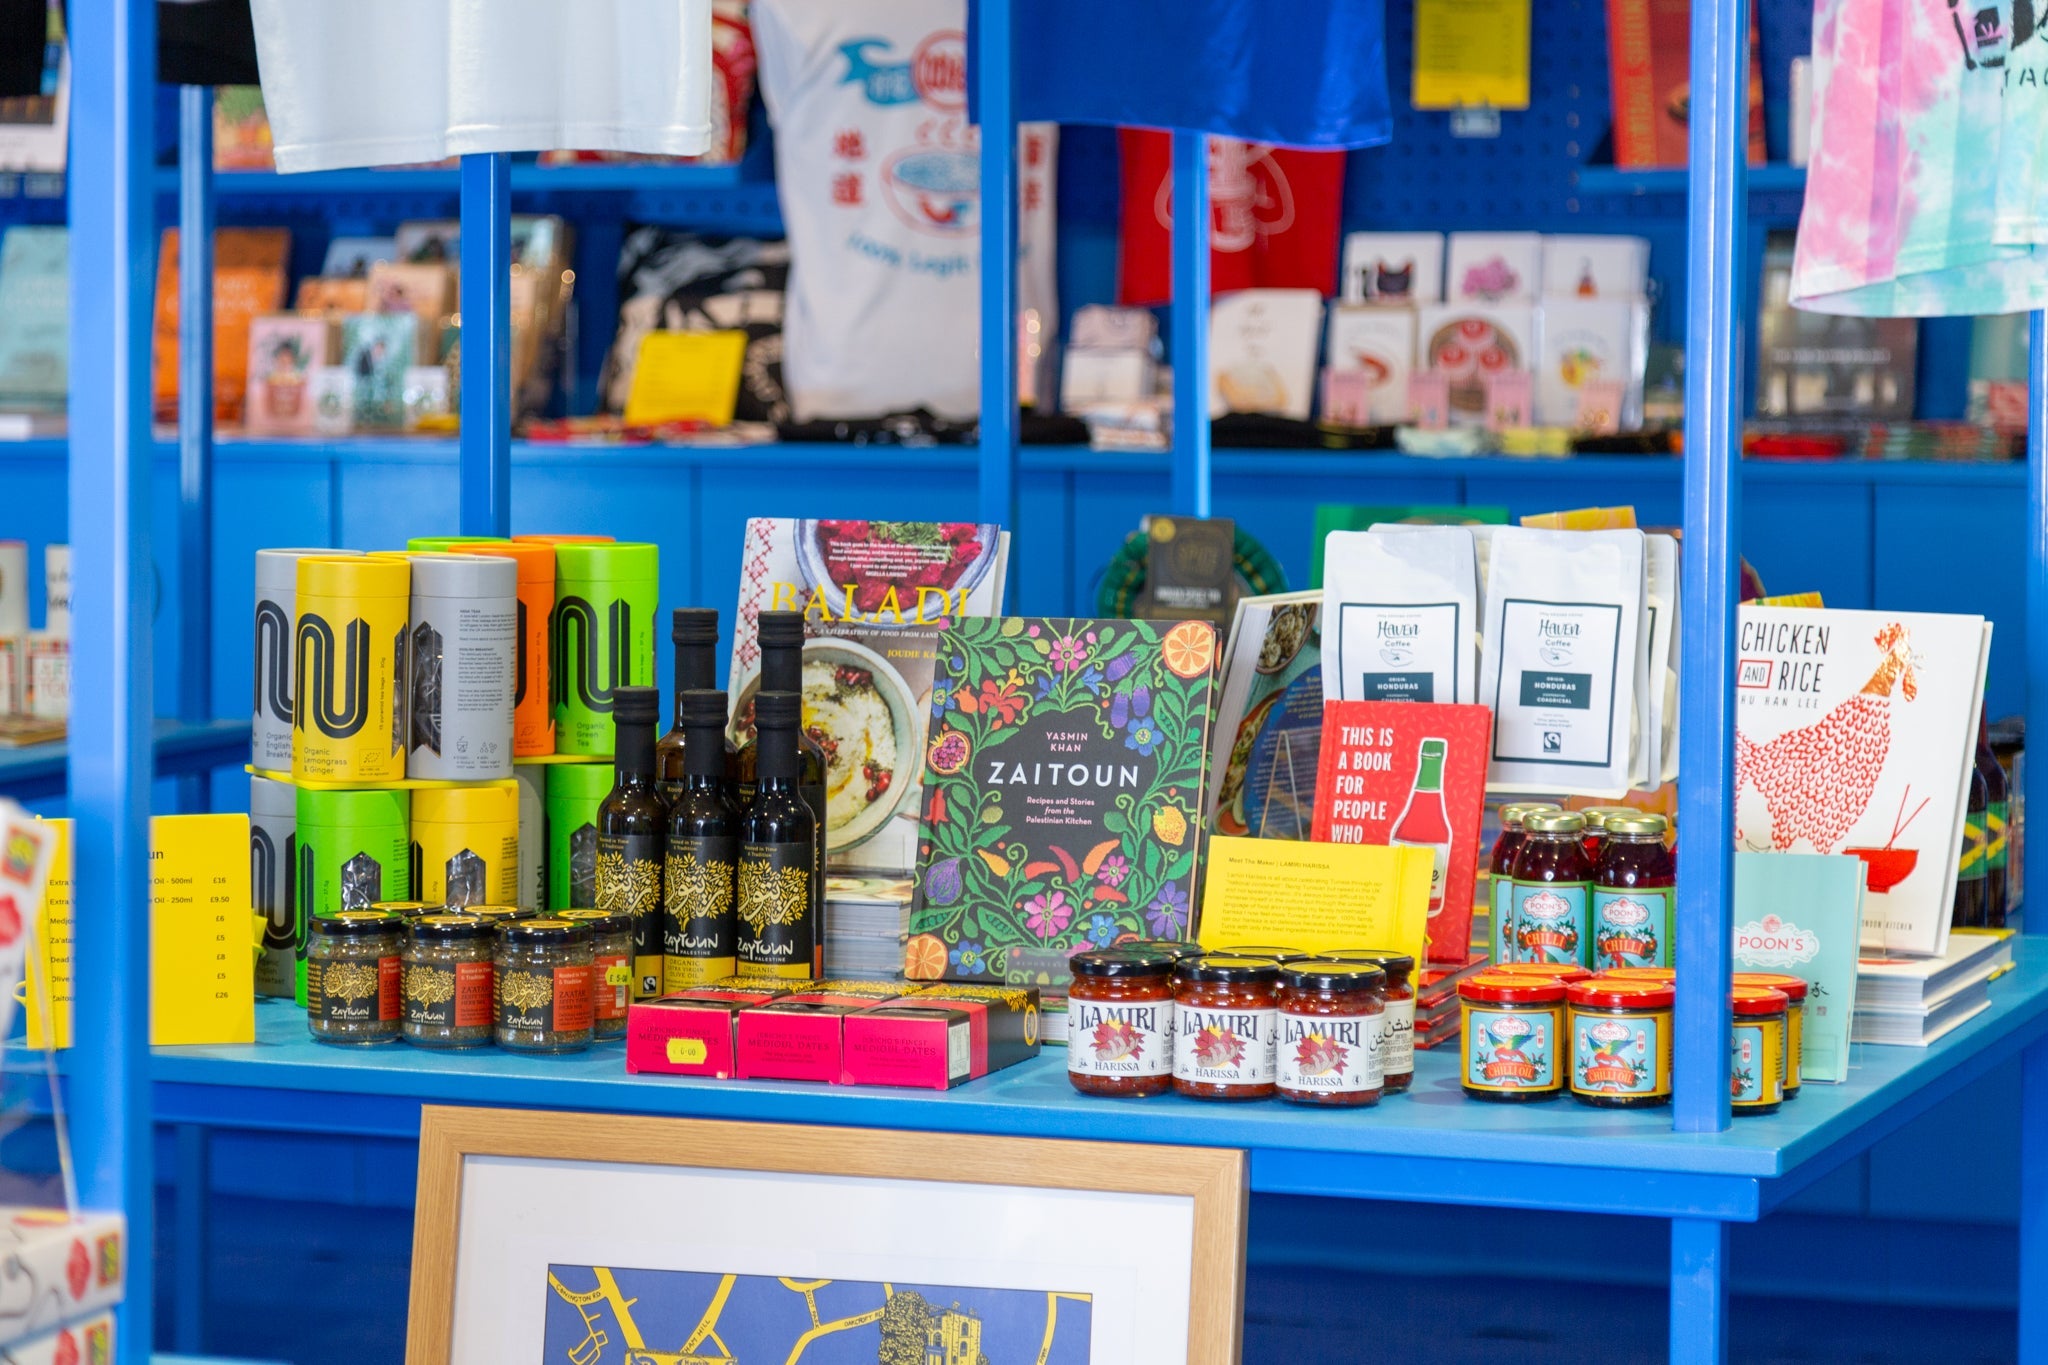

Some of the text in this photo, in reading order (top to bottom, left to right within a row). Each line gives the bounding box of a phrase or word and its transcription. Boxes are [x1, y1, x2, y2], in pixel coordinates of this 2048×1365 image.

[770, 581, 972, 624] BALADI
[1385, 640, 1410, 648] Coffee
[1546, 640, 1571, 648] Coffee
[1741, 622, 1830, 655] CHICKEN
[887, 649, 921, 658] JOUDIE
[1744, 661, 1824, 692] AND RICE
[1534, 682, 1576, 691] HONDURAS
[577, 722, 605, 732] Organic
[266, 732, 292, 743] Organic
[1046, 731, 1088, 742] YASMIN
[1341, 726, 1394, 747] THIS IS
[266, 742, 291, 752] English
[304, 746, 330, 756] Organic
[1050, 743, 1081, 752] KHAN
[266, 750, 292, 759] Breakfa
[304, 756, 347, 768] Lemongrass
[1338, 752, 1392, 771] A BOOK
[310, 766, 334, 777] Ginger
[988, 762, 1138, 788] ZAITOUN
[1336, 775, 1364, 795] FOR
[1026, 797, 1095, 807] Recipes and Stories
[1044, 807, 1062, 816] from
[1334, 800, 1387, 820] PEOPLE
[1026, 816, 1092, 825] Palestinian Kitchen
[1331, 825, 1363, 844] WHO
[171, 877, 193, 885] 500ml
[50, 896, 230, 906] Extra Oil 250ml £9.50
[50, 918, 75, 927] Medjo
[1885, 922, 1912, 932] KITCHEN
[216, 934, 226, 942] £5
[1525, 930, 1565, 949] CHILLI
[1738, 936, 1804, 951] POON'S
[1604, 938, 1644, 956] CHILLI
[50, 956, 70, 964] Dead
[670, 959, 700, 967] ORGANIC
[744, 966, 775, 974] ORGANIC
[217, 972, 226, 980] £5
[216, 992, 228, 1000] £26
[1080, 1005, 1157, 1032] LAMIRI
[1183, 1010, 1258, 1042] LAMIRI
[1284, 1019, 1361, 1048] LAMIRI
[797, 1042, 830, 1052] DATES
[902, 1038, 928, 1046] FINEST
[904, 1046, 936, 1056] DATES
[1095, 1061, 1140, 1072] HARISSA
[1488, 1066, 1532, 1078] CHILLI OIL
[1196, 1068, 1240, 1080] HARISSA
[1588, 1070, 1632, 1083] CHILLI OIL
[1298, 1076, 1343, 1087] HARISSA
[592, 1291, 602, 1299] RD
[812, 1311, 820, 1328] PARK
[844, 1316, 873, 1327] OAKCROFT
[697, 1318, 711, 1336] HILL
